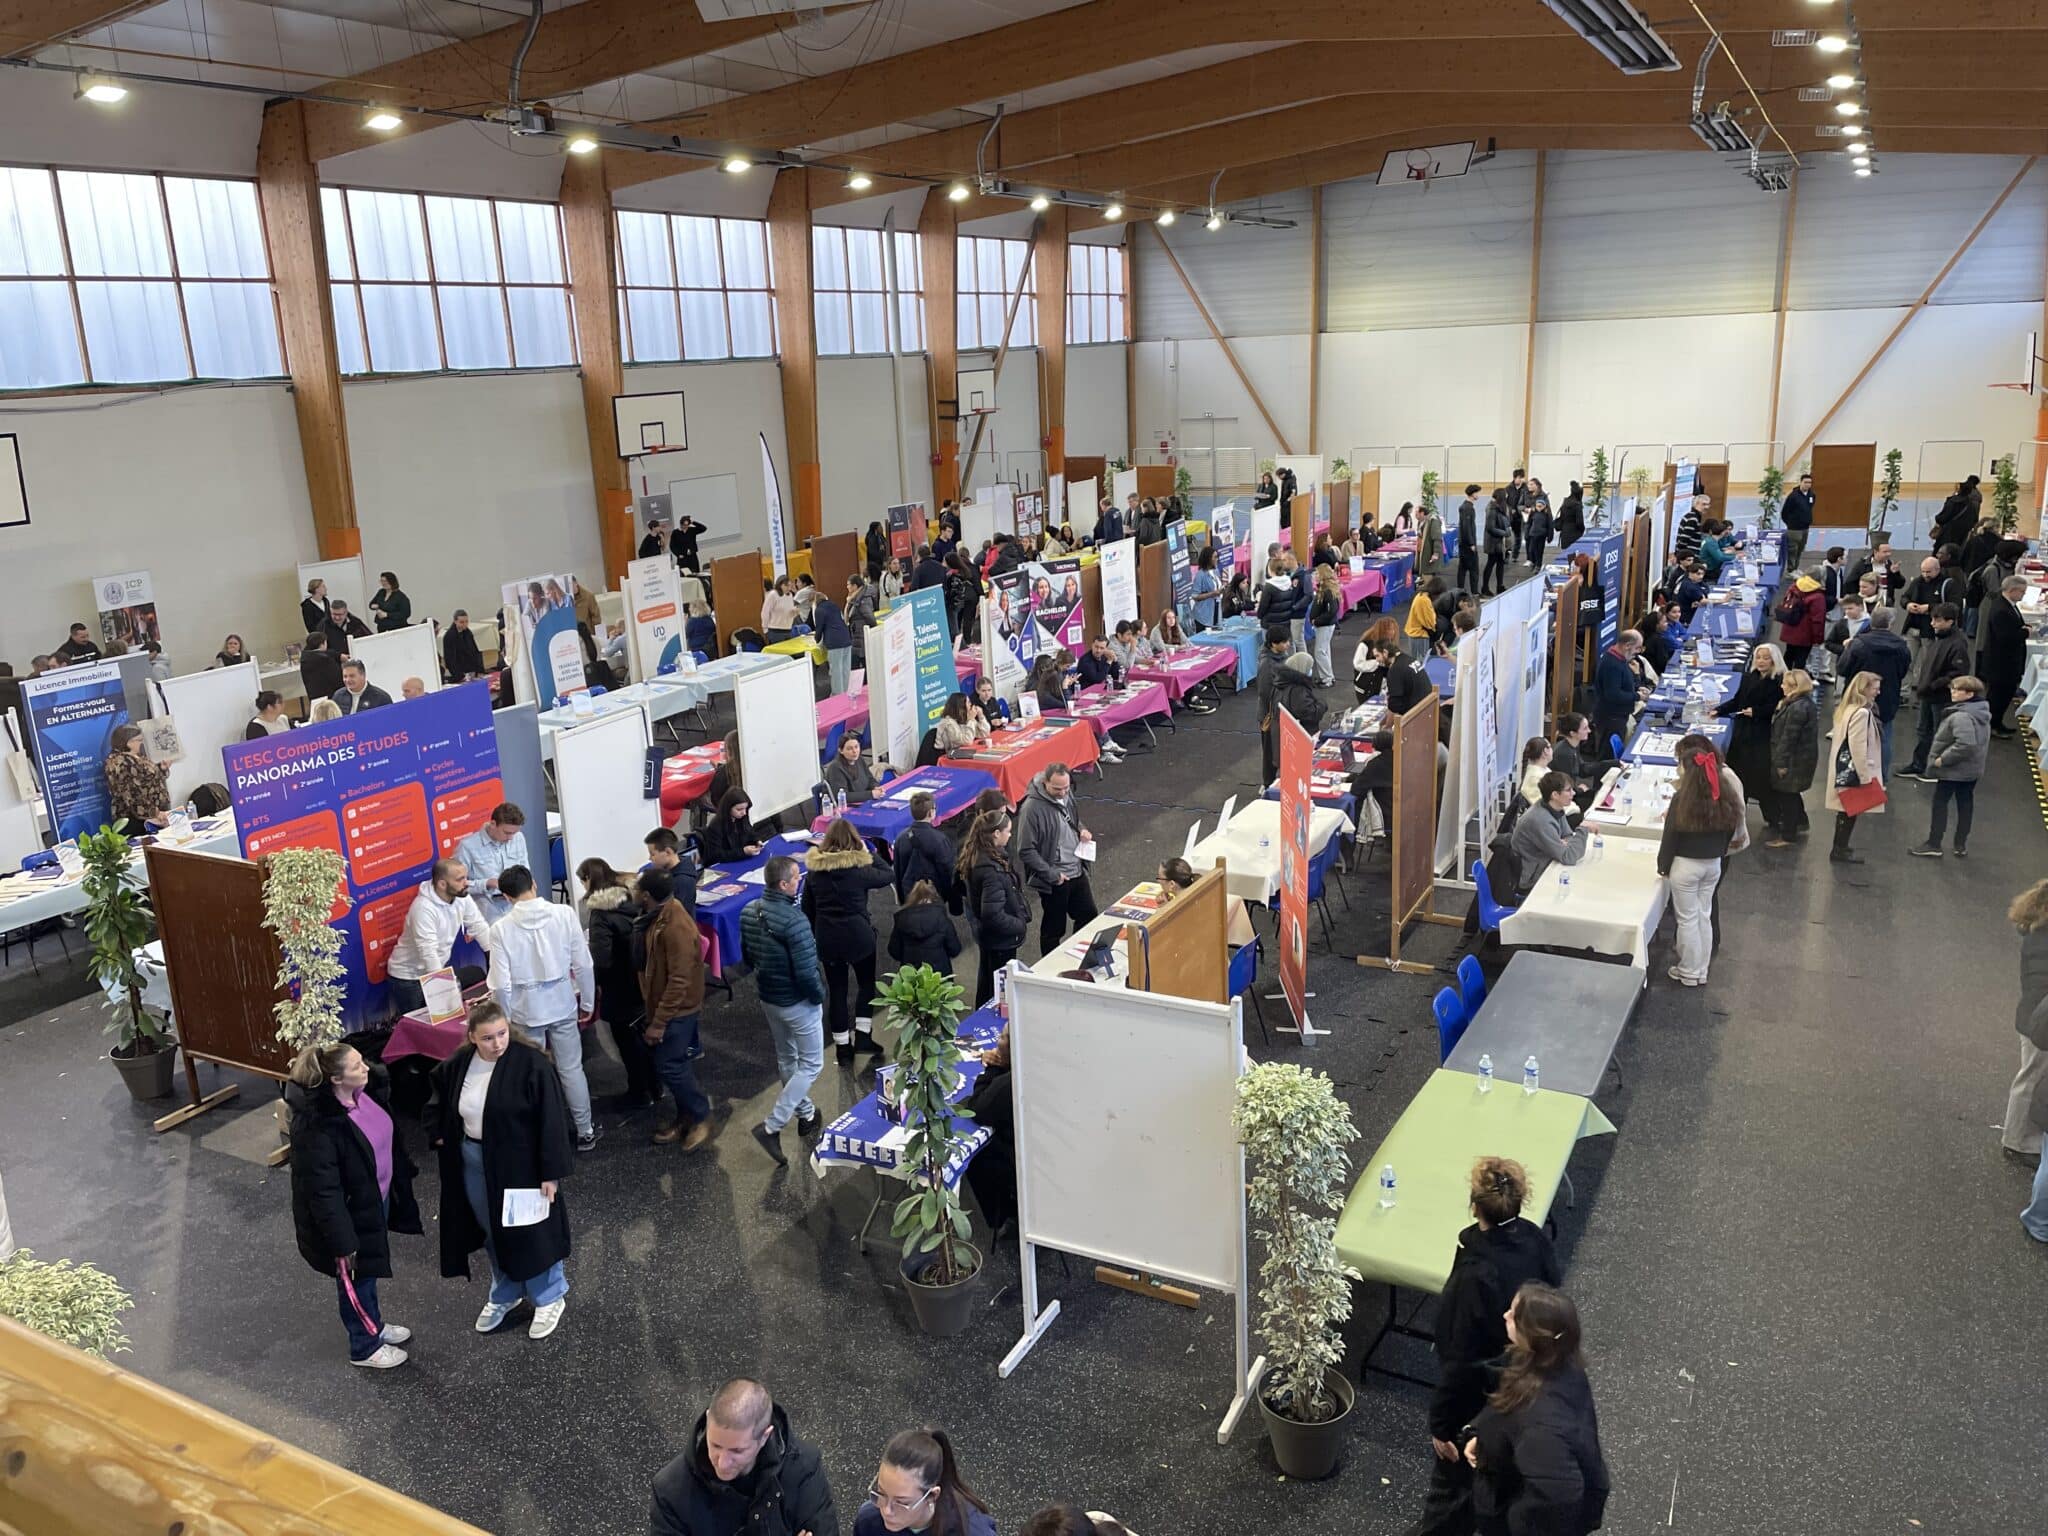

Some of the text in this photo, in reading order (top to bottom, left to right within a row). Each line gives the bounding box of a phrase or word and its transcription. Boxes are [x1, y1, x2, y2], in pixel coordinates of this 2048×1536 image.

[125, 579, 143, 589] ICP
[917, 623, 938, 634] Talents
[35, 670, 112, 691] Licence Immobilier
[53, 698, 105, 714] Formez-vous
[61, 704, 116, 722] ALTERNANCE
[46, 750, 78, 762] Licence
[232, 732, 355, 772] L'ESC Compiègne
[237, 732, 409, 790] PANORAMA DES ÉTUDES
[252, 814, 269, 826] BTS
[366, 880, 397, 896] Licences
